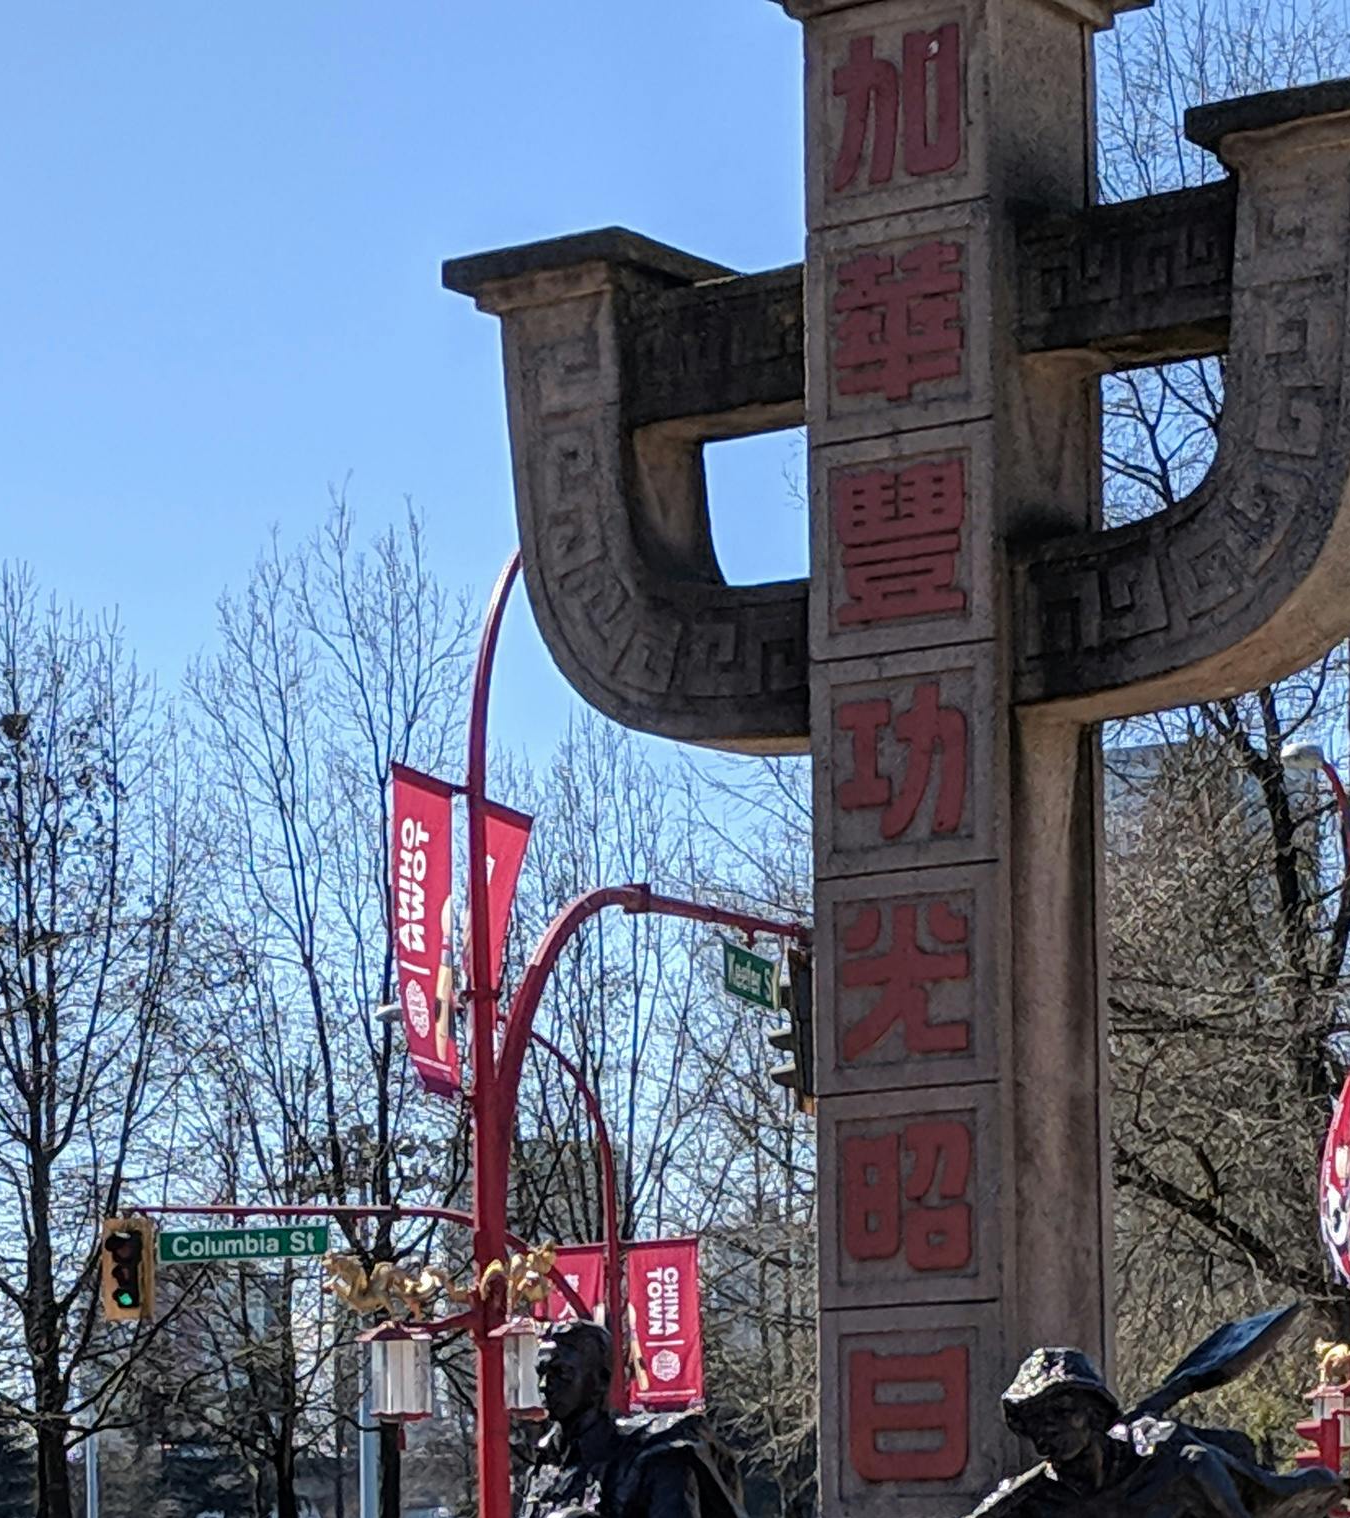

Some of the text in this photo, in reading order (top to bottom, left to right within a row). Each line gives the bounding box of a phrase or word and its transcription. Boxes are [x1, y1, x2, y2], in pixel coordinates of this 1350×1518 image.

[170, 1230, 316, 1257] Columbia St
[646, 1267, 664, 1336] TOWN
[664, 1266, 680, 1336] CHINA
